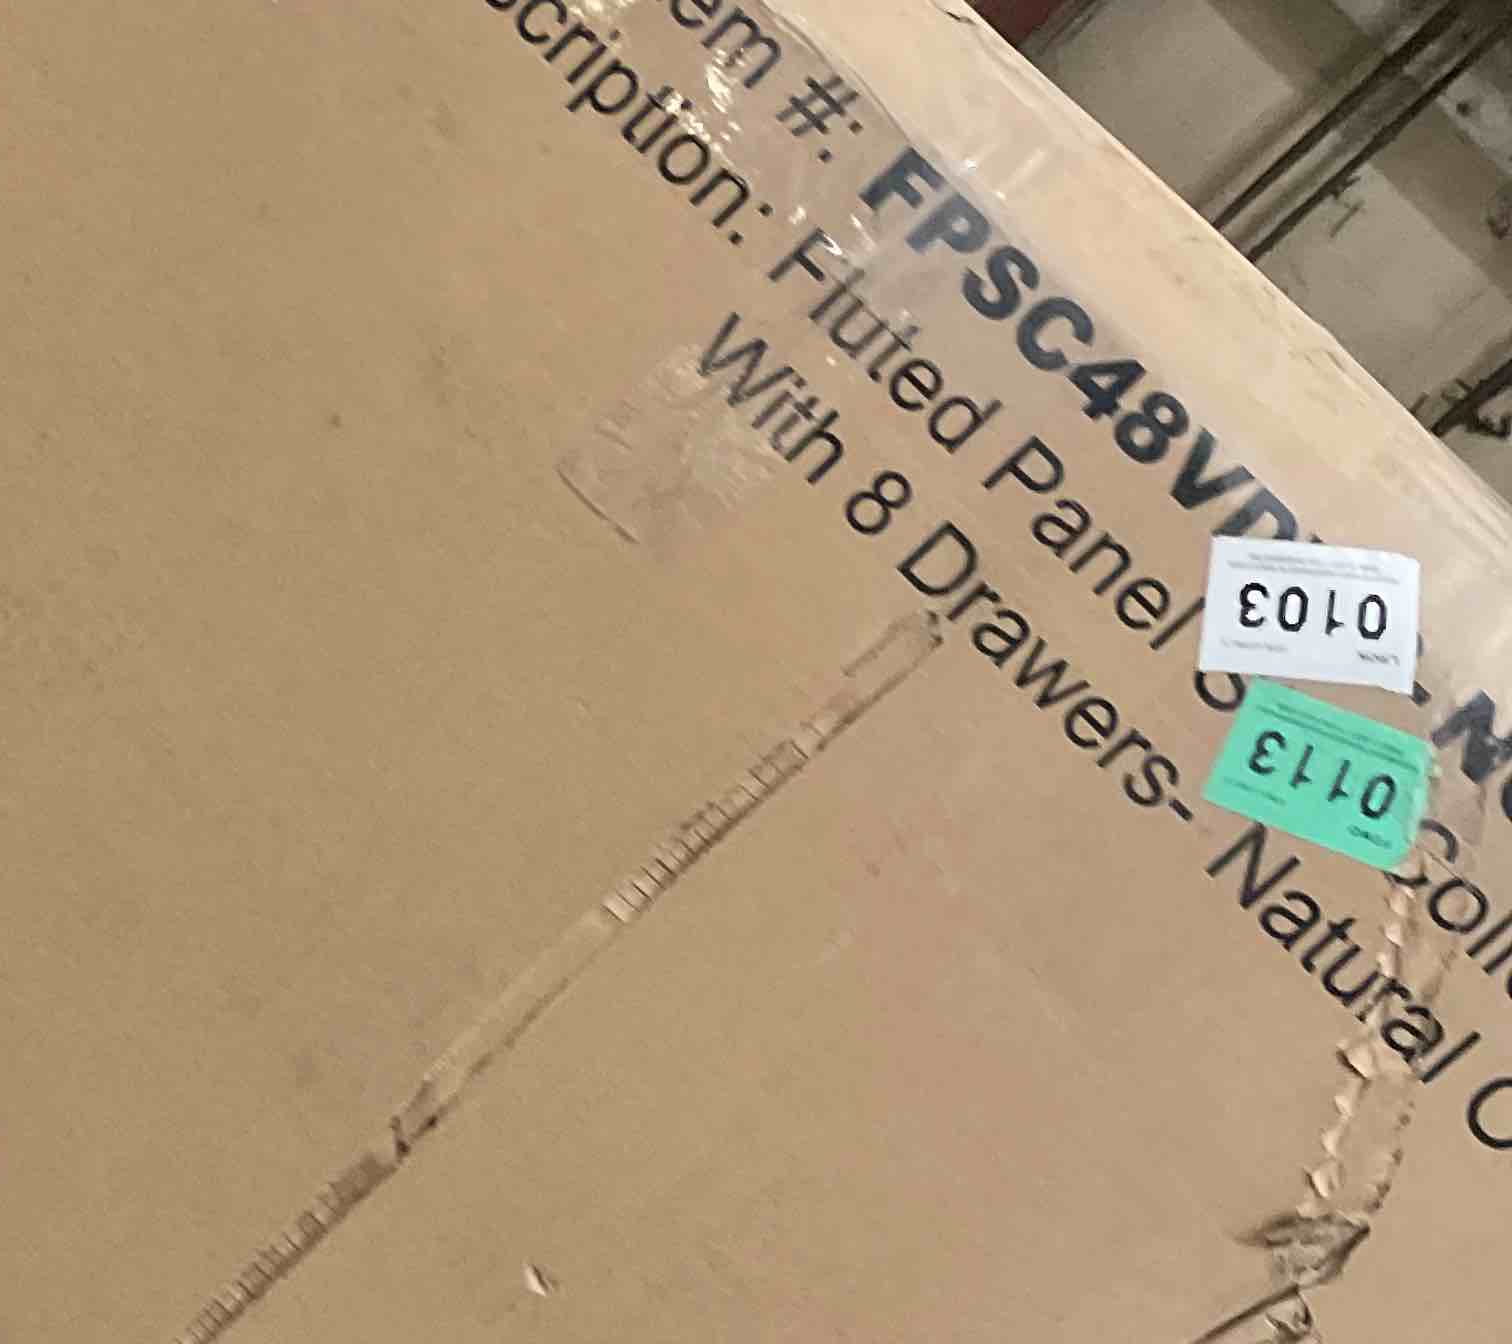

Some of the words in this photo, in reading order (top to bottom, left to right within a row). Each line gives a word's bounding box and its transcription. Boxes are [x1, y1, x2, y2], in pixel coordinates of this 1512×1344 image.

[775, 74, 864, 164] #:
[768, 227, 1005, 455] Fluted
[981, 434, 1206, 652] Panel
[1238, 581, 1388, 641] 0103
[695, 311, 845, 485] With
[843, 469, 914, 537] 8
[895, 519, 1195, 823] Drawers-
[1205, 821, 1482, 1085] Natural
[1247, 729, 1398, 820] 0113
